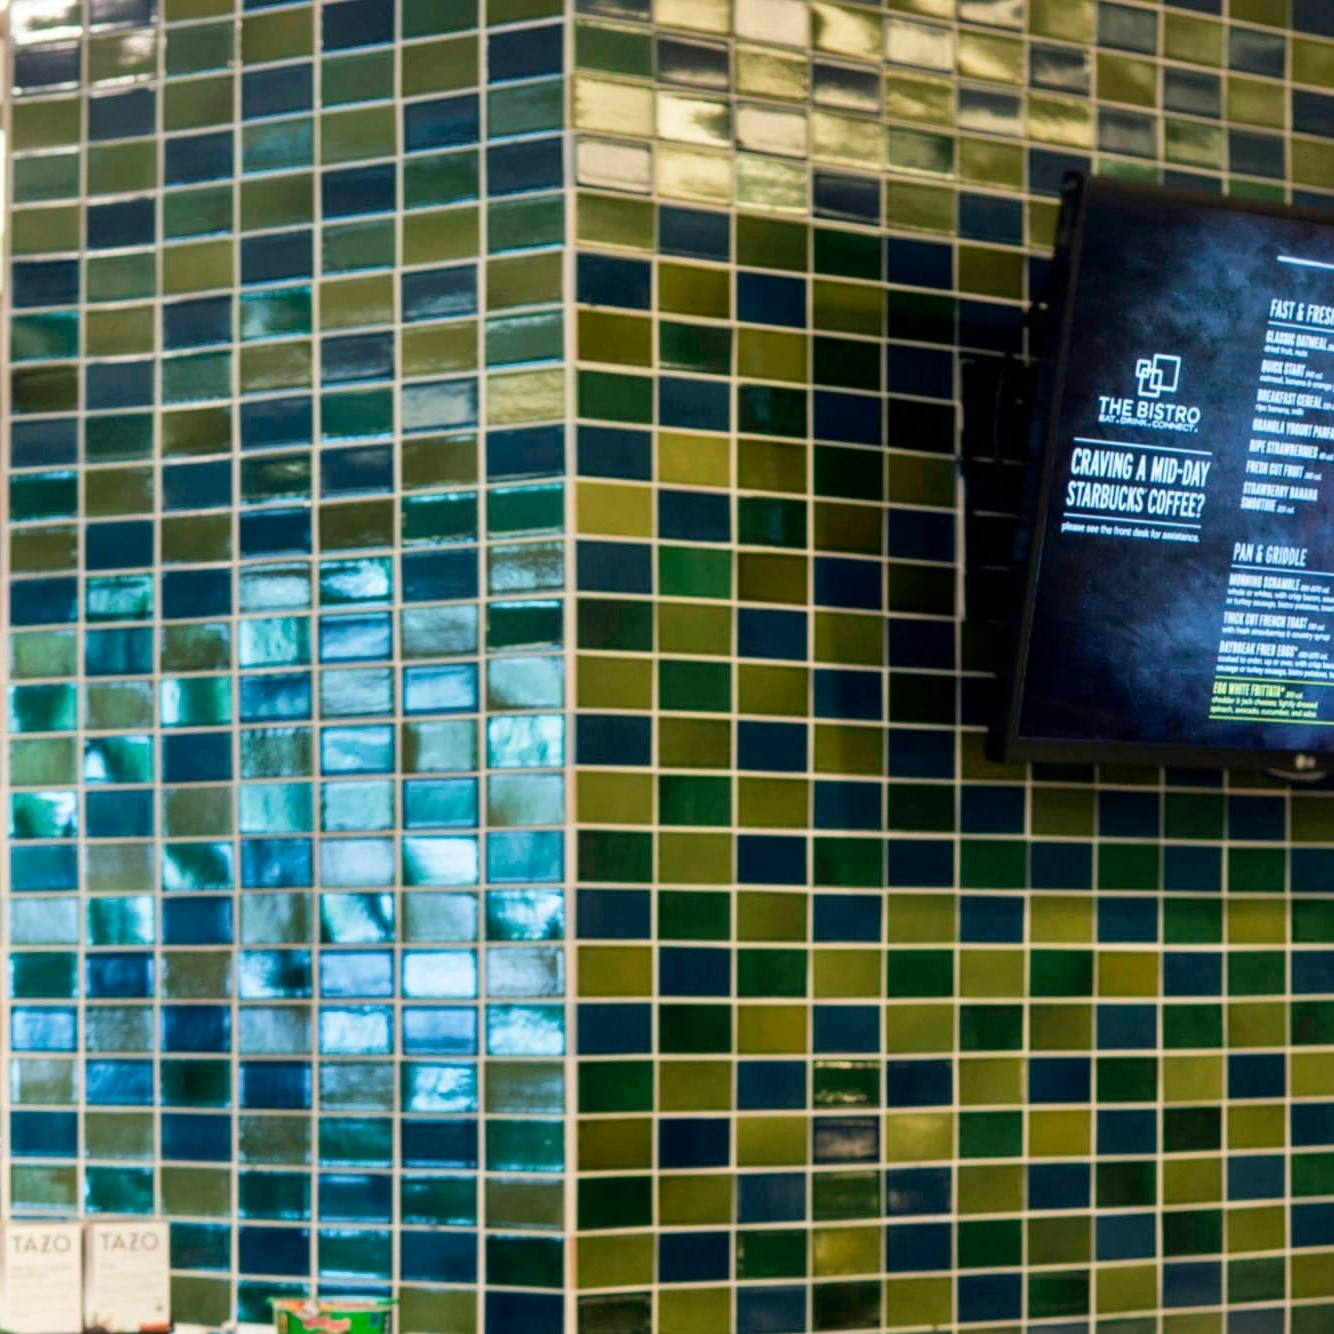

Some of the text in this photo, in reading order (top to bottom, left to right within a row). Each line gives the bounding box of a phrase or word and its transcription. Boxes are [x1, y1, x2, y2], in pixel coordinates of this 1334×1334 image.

[1269, 299, 1296, 320] FAST
[1296, 304, 1306, 321] &
[1284, 363, 1306, 377] START
[1256, 389, 1297, 405] BREAKFAST
[1098, 396, 1201, 425] THE BISTRO
[1070, 447, 1211, 487] CRAVING A MID-DAY
[1147, 489, 1206, 519] COFFEE?
[1061, 522, 1085, 533] please
[1086, 525, 1099, 533] see
[1100, 525, 1112, 534] the
[1113, 526, 1132, 537] front
[1133, 528, 1149, 538] desk
[1150, 530, 1162, 540] for
[1233, 542, 1307, 567] PAN & GRIDDLE
[11, 1234, 72, 1254] TAZO
[99, 1231, 160, 1252] TAZO
